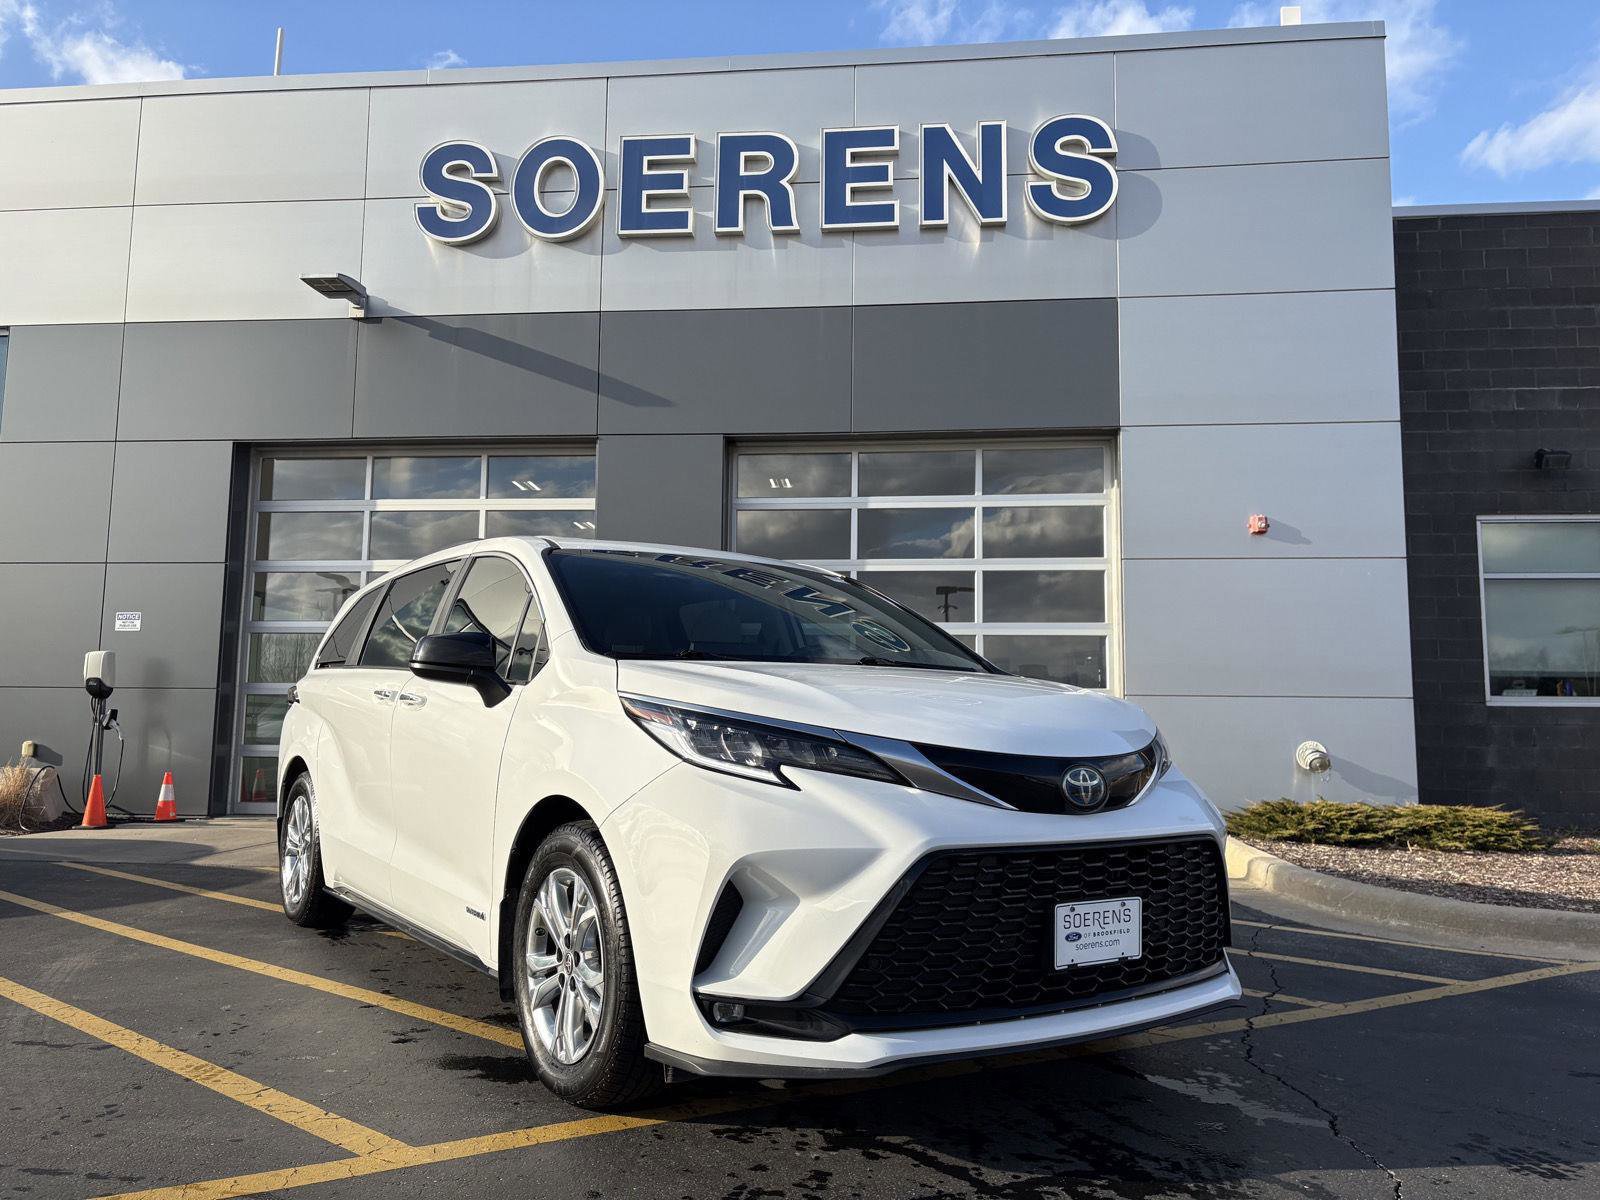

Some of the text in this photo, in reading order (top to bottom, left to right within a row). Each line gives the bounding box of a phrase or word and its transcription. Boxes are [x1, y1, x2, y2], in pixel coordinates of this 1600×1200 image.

[413, 113, 1119, 246] SOERENS
[1063, 908, 1132, 930] SOERENS
[1093, 928, 1131, 938] BROOKFIELD
[1075, 939, 1121, 951] soerens.com
